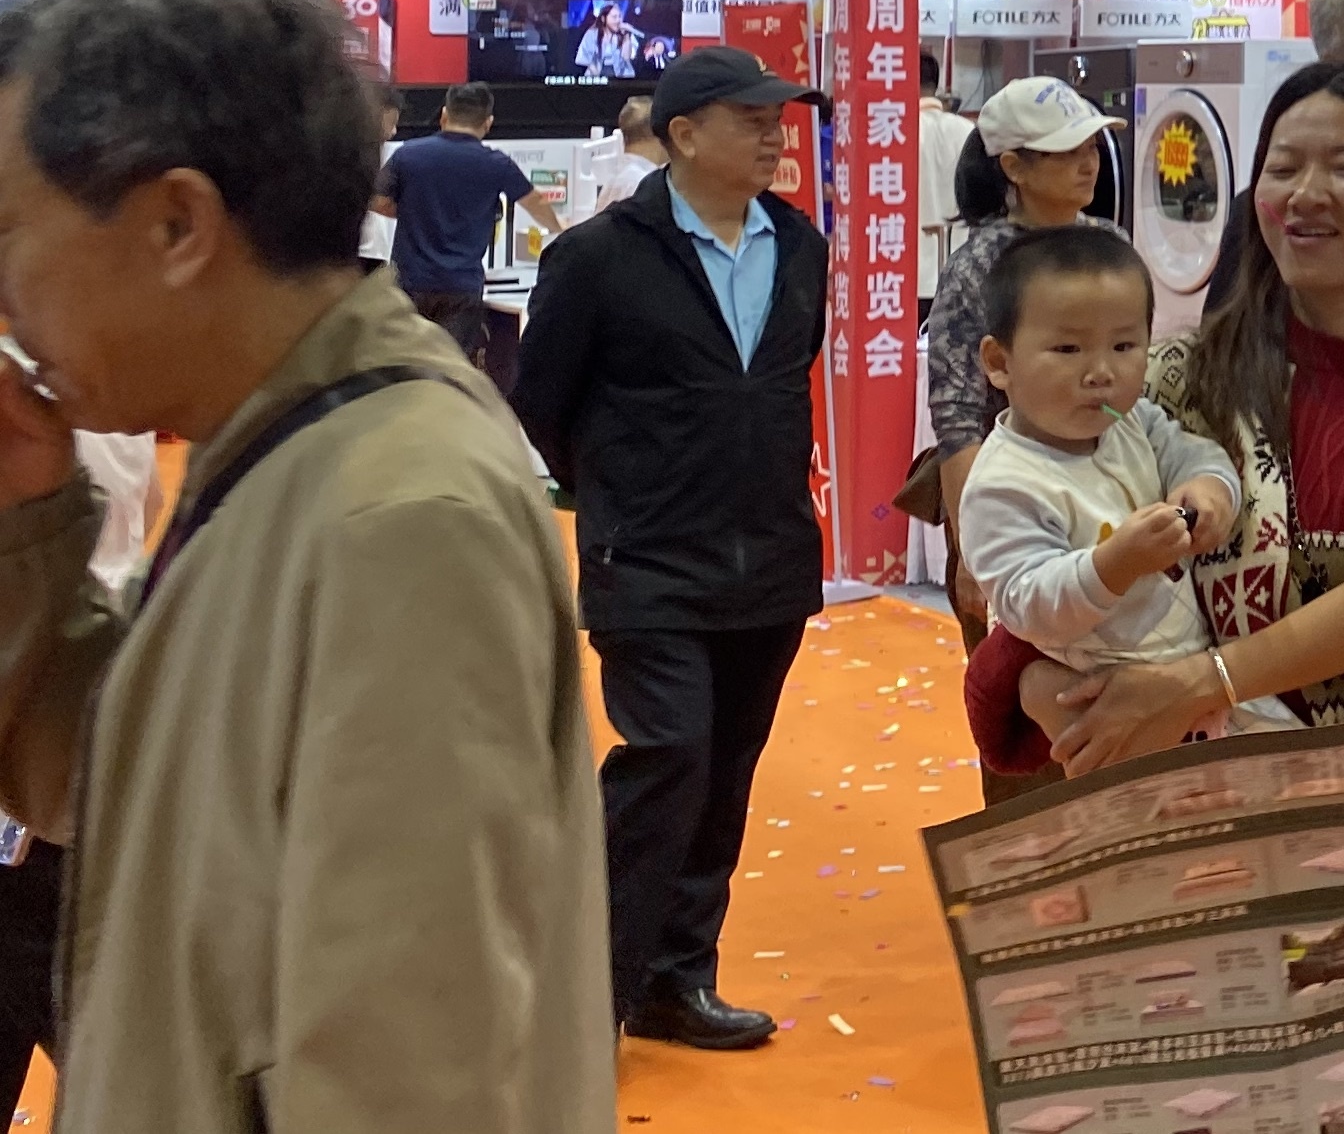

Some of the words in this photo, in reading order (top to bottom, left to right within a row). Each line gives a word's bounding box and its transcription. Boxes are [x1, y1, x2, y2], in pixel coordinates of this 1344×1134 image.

[973, 10, 1028, 24] FOTILE
[1032, 10, 1061, 25] 方太
[1097, 11, 1150, 26] FOTILE
[1154, 11, 1181, 27] 方太
